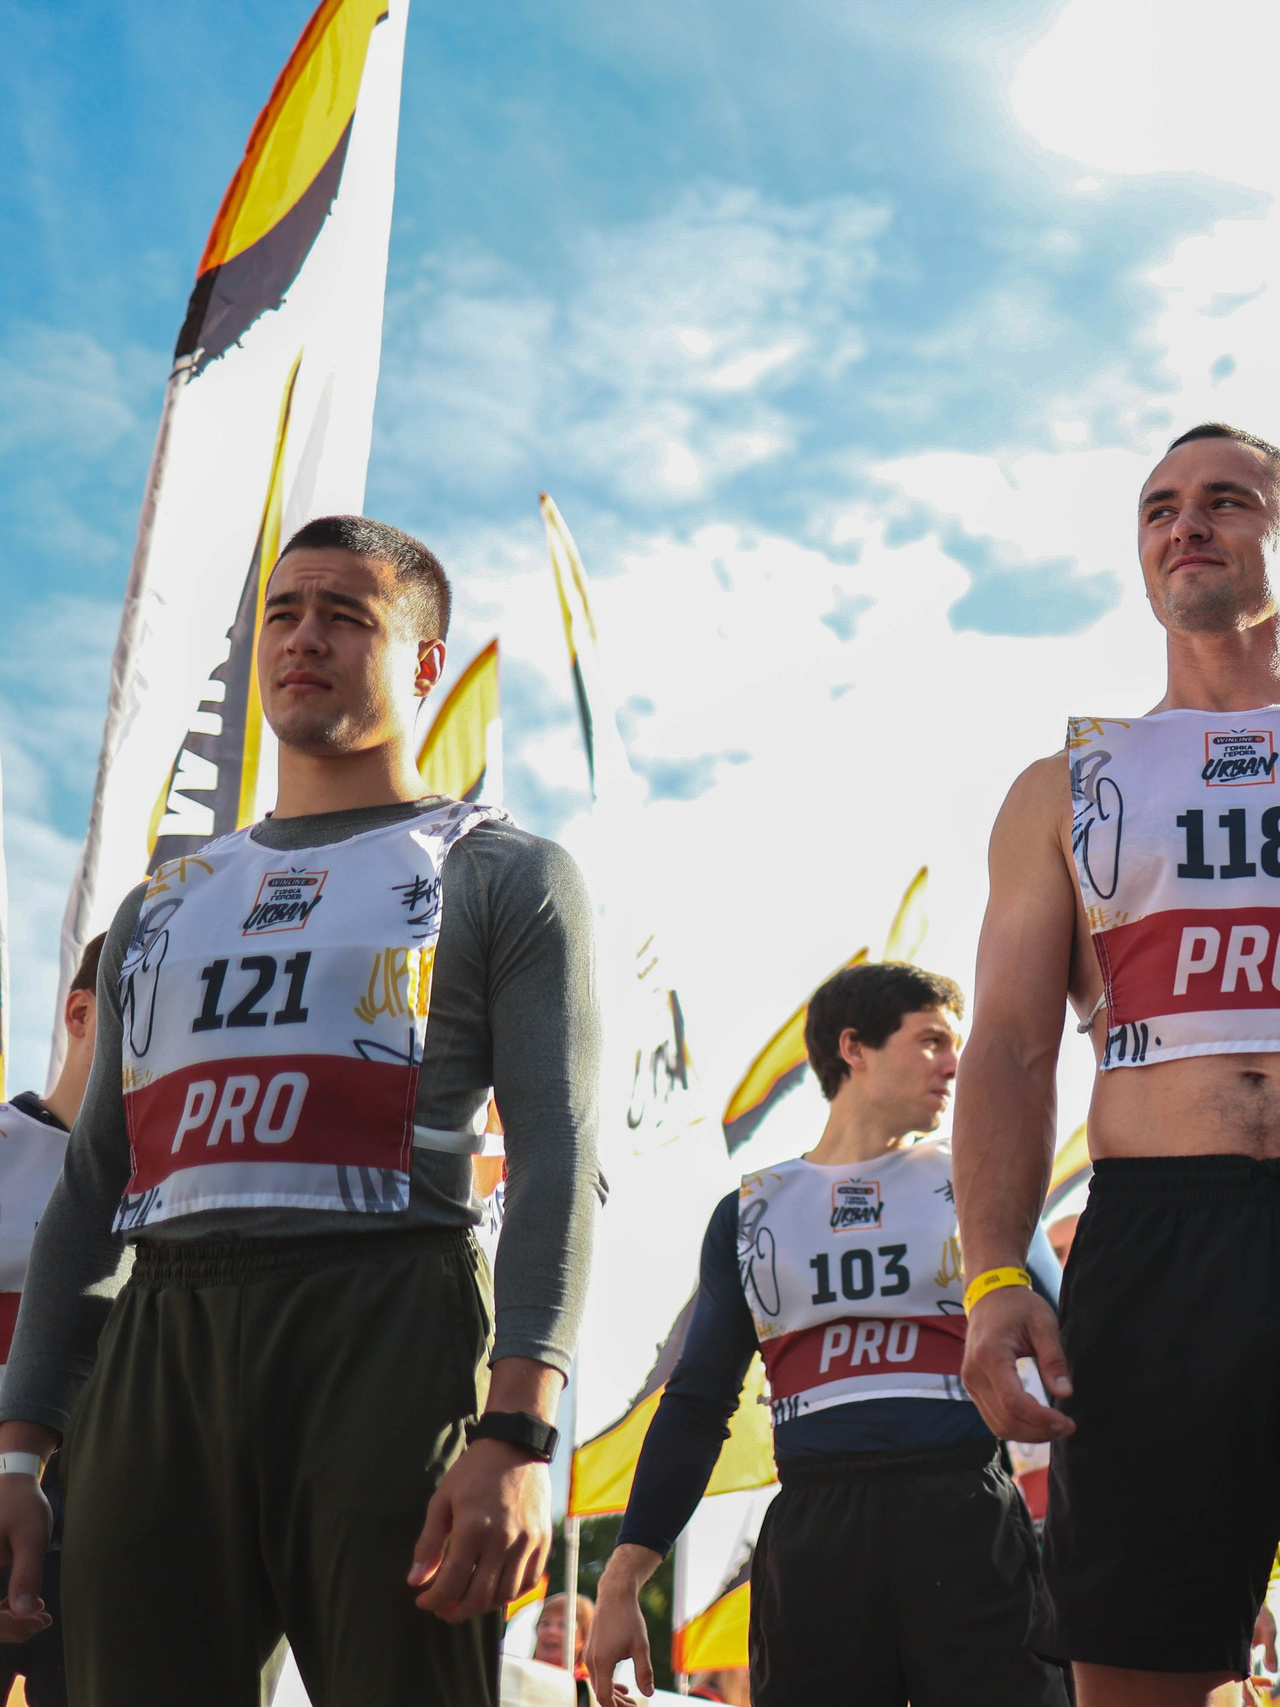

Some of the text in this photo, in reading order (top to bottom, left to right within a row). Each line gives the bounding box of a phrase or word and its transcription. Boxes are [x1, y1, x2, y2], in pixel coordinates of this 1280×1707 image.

[1201, 752, 1279, 780] URBAN
[243, 895, 322, 929] URBAN
[191, 951, 312, 1033] 121
[170, 1071, 309, 1155] PRO
[830, 1202, 884, 1227] URBAN
[809, 1244, 910, 1305] 103
[819, 1320, 919, 1374] PRO
